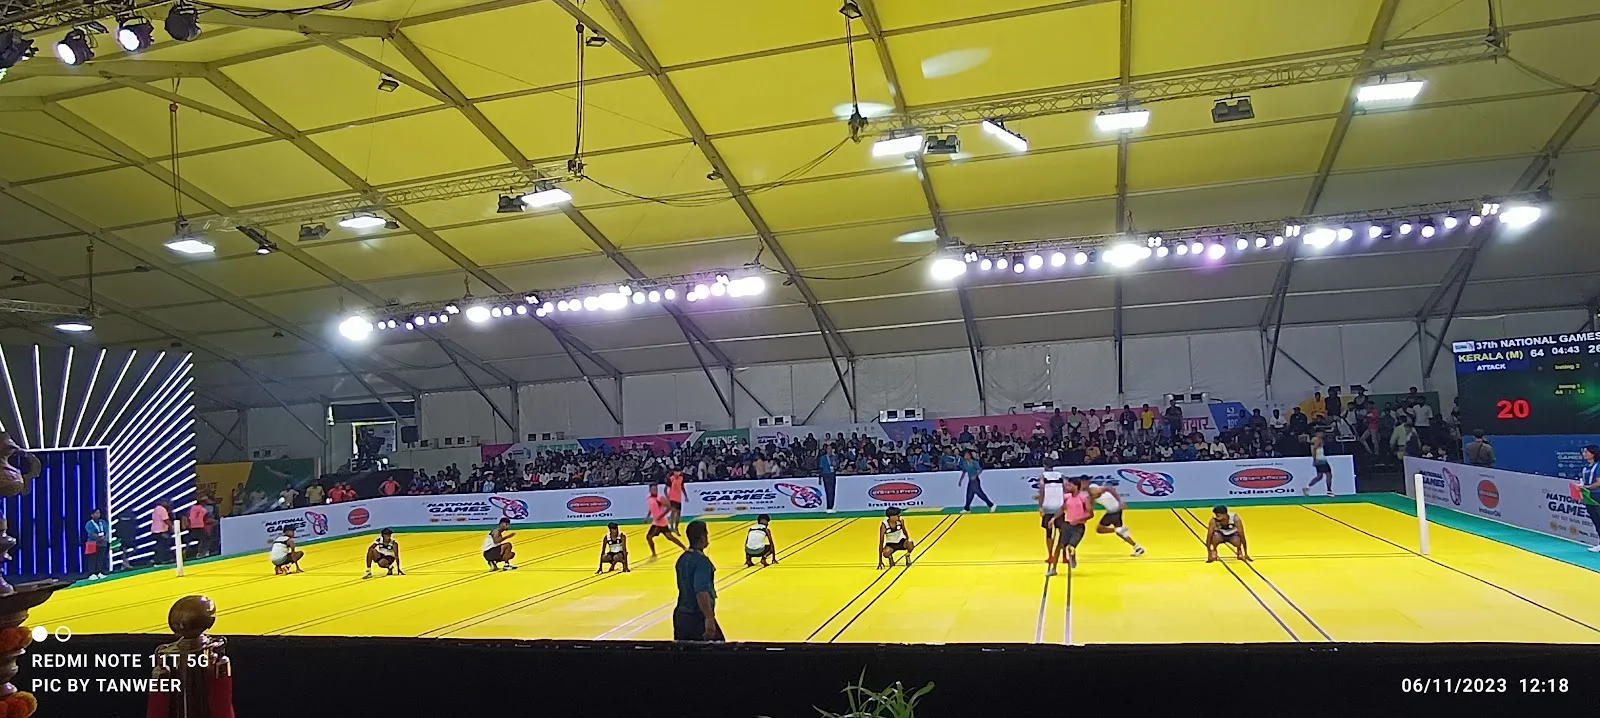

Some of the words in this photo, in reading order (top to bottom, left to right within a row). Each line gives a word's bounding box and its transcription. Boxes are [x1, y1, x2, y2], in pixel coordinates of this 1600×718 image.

[1476, 341, 1498, 350] 37th
[1500, 336, 1557, 348] NATIONAL
[1559, 331, 1600, 343] GAMES
[1530, 349, 1545, 357] 64
[1552, 346, 1580, 355] 04:43
[1458, 352, 1504, 362] KERALA
[1506, 350, 1524, 361] (M)
[1477, 363, 1506, 371] ATTACK
[1496, 399, 1530, 419] 20
[700, 488, 773, 496] NATIONAL
[701, 493, 778, 502] GAMES
[428, 505, 492, 513] GAMES
[265, 516, 304, 527] NATIONAL
